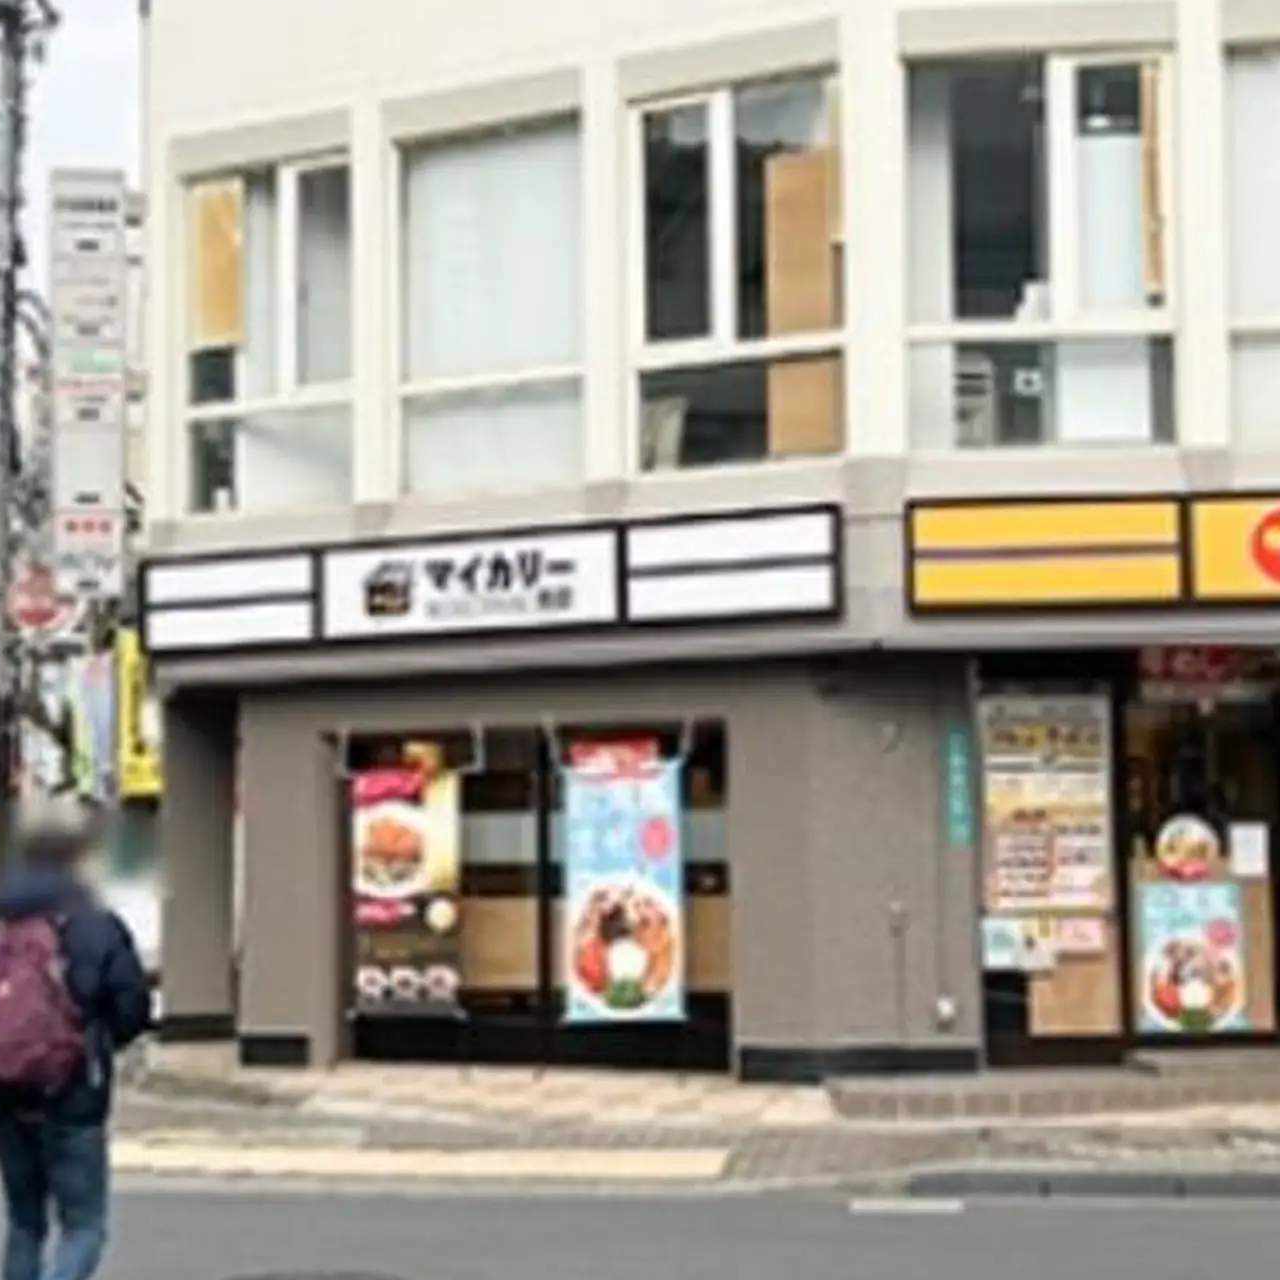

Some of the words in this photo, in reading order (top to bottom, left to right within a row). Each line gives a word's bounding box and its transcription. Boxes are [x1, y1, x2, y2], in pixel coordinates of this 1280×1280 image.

[424, 549, 576, 593] マイカリー
